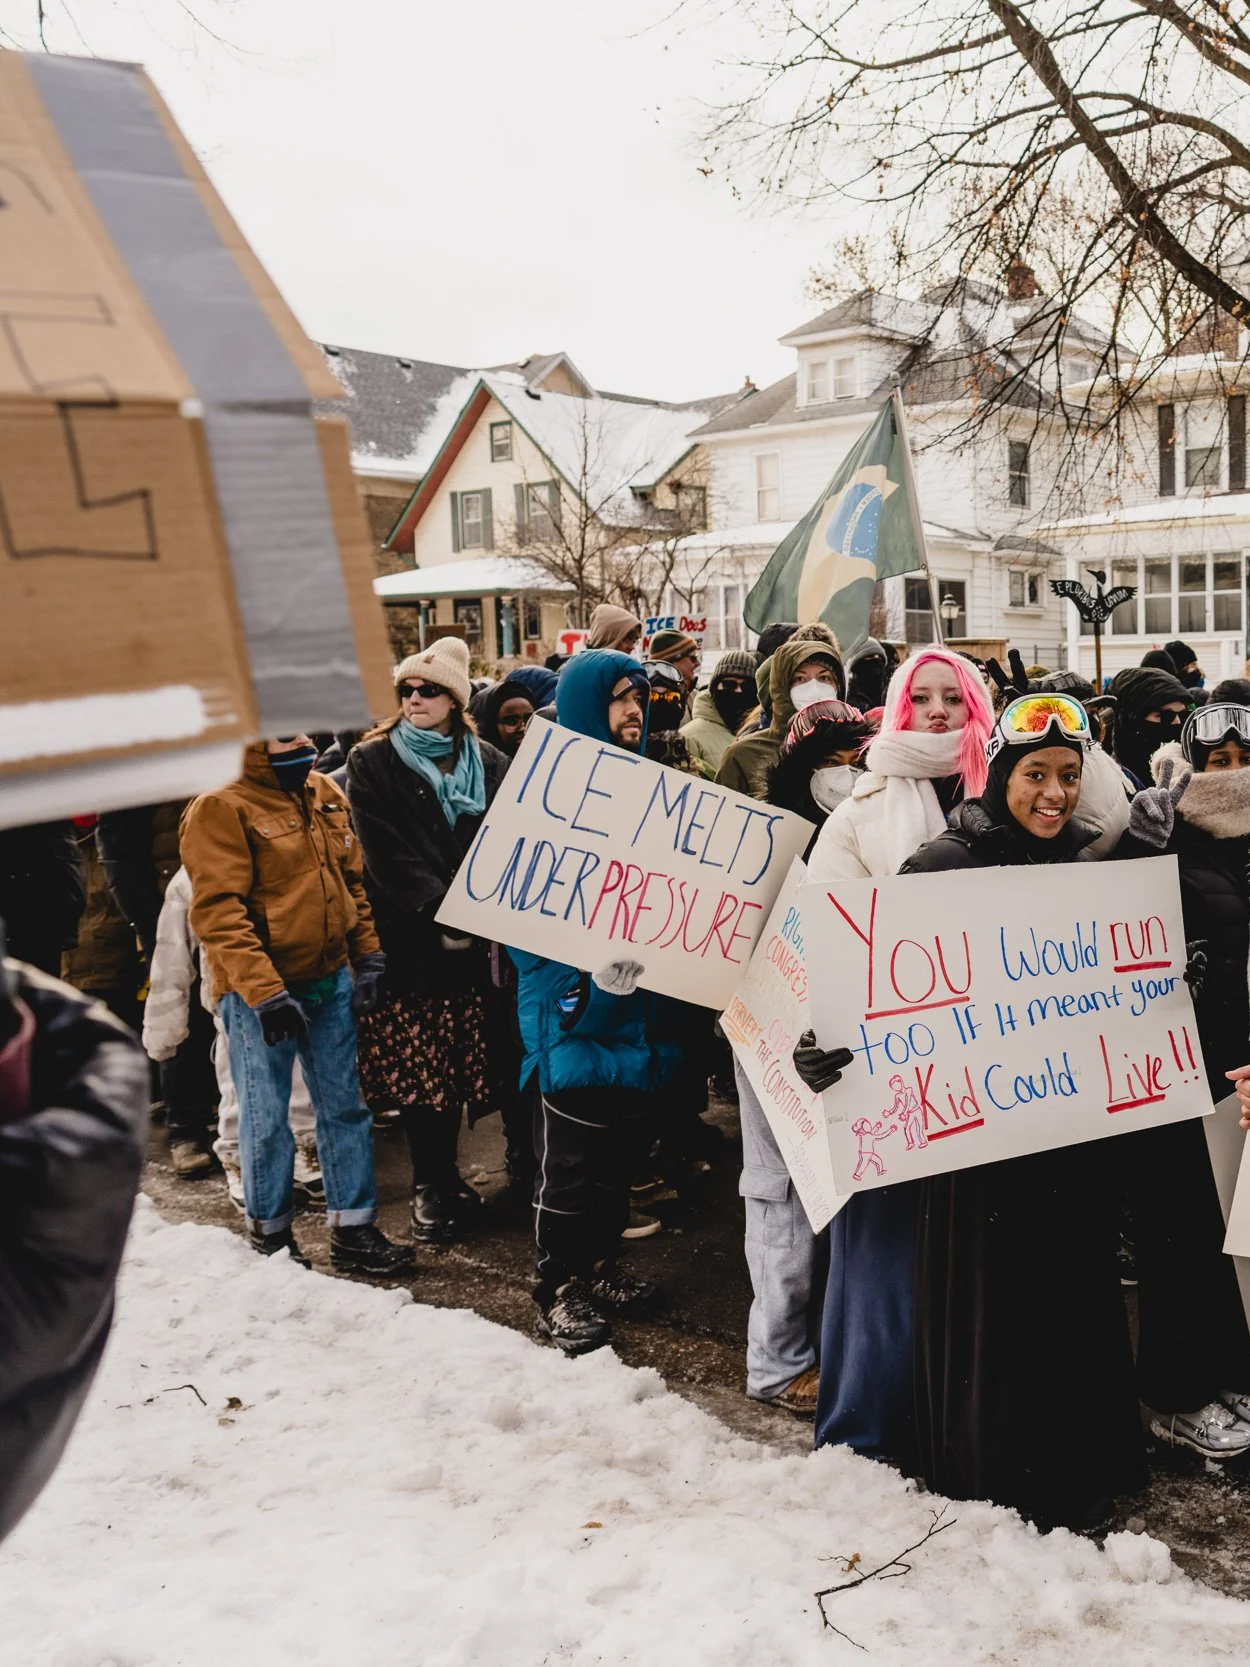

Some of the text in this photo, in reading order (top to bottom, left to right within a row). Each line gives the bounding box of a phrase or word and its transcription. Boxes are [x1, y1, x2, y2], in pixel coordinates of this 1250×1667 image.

[646, 616, 675, 635] ICE
[1056, 582, 1064, 594] E
[1065, 581, 1097, 609] PLURIBUS
[516, 727, 784, 886] ICE MELTS
[465, 824, 763, 965] UNDER PRESSURE
[827, 887, 972, 1008] YOU
[1109, 916, 1170, 961] run
[729, 995, 764, 1043] PERVERT
[755, 1038, 773, 1068] THE
[851, 1022, 935, 1075] too
[1026, 985, 1123, 1027] meant
[1131, 974, 1180, 1017] your
[762, 1058, 819, 1142] CONSTITUTION
[914, 1063, 982, 1130] Kid
[983, 1052, 1079, 1111] Could
